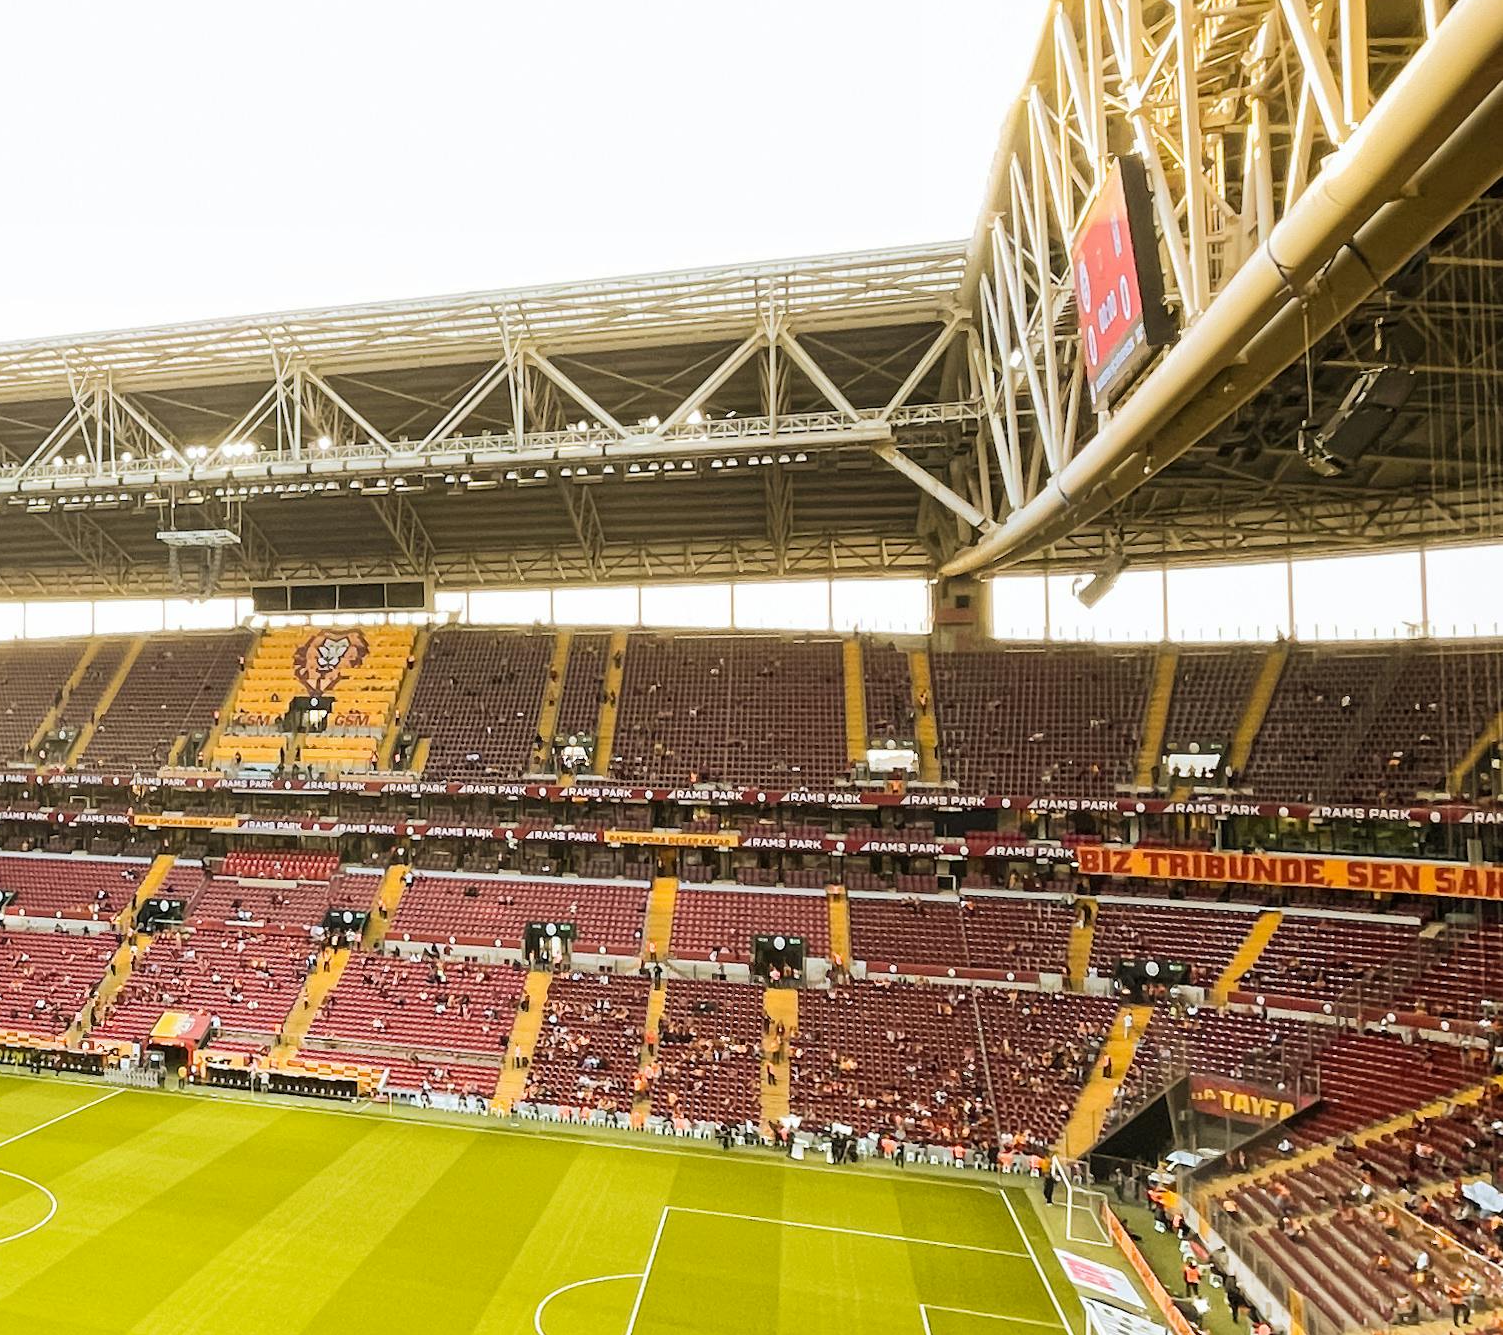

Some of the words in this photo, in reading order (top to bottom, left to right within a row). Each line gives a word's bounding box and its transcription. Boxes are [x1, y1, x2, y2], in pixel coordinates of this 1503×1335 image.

[335, 715, 370, 727] GSM
[6, 774, 27, 782] PARK
[55, 776, 79, 784] RAMS
[80, 776, 102, 784] PARK
[136, 777, 161, 786] RAMS
[163, 777, 186, 786] PARK
[221, 780, 247, 789] RAMS
[249, 780, 274, 789] PARK
[310, 781, 338, 791] RAMS
[339, 781, 366, 791] PARK
[388, 783, 417, 793] RAMS
[419, 783, 447, 793] PARK
[466, 784, 496, 796] RAMS
[498, 784, 527, 796] PARK
[569, 787, 599, 798] RAMS
[601, 787, 633, 798] PARK
[677, 789, 709, 801] RAMS
[711, 789, 743, 801] PARK
[791, 792, 826, 803] RAMS
[828, 792, 861, 803] PARK
[911, 795, 947, 806] RAMS
[951, 795, 985, 806] PARK
[1038, 799, 1077, 810] RAMS
[1081, 799, 1118, 810] PARK
[1175, 803, 1216, 815] RAMS
[1221, 803, 1260, 815] PARK
[1322, 807, 1365, 820] RAMS
[1369, 807, 1411, 820] PARK
[1, 811, 25, 821] RAMS
[27, 811, 49, 821] PARK
[80, 814, 104, 824] RAMS
[106, 814, 129, 824] PARK
[247, 821, 275, 831] RAMS
[277, 821, 302, 831] PARK
[339, 823, 367, 834] RAMS
[369, 823, 396, 834] PARK
[434, 827, 463, 838] RAMS
[465, 827, 494, 838] PARK
[535, 830, 565, 842] RAMS
[567, 830, 597, 842] PARK
[753, 838, 786, 850] RAMS
[789, 838, 822, 850] PARK
[871, 842, 907, 853] RAMS
[910, 842, 944, 853] PARK
[997, 846, 1035, 858] RAMS
[1038, 846, 1074, 858] PARK
[1081, 851, 1132, 874] BIZ
[1348, 861, 1420, 892] SEN
[1219, 1090, 1295, 1121] TAYFA
